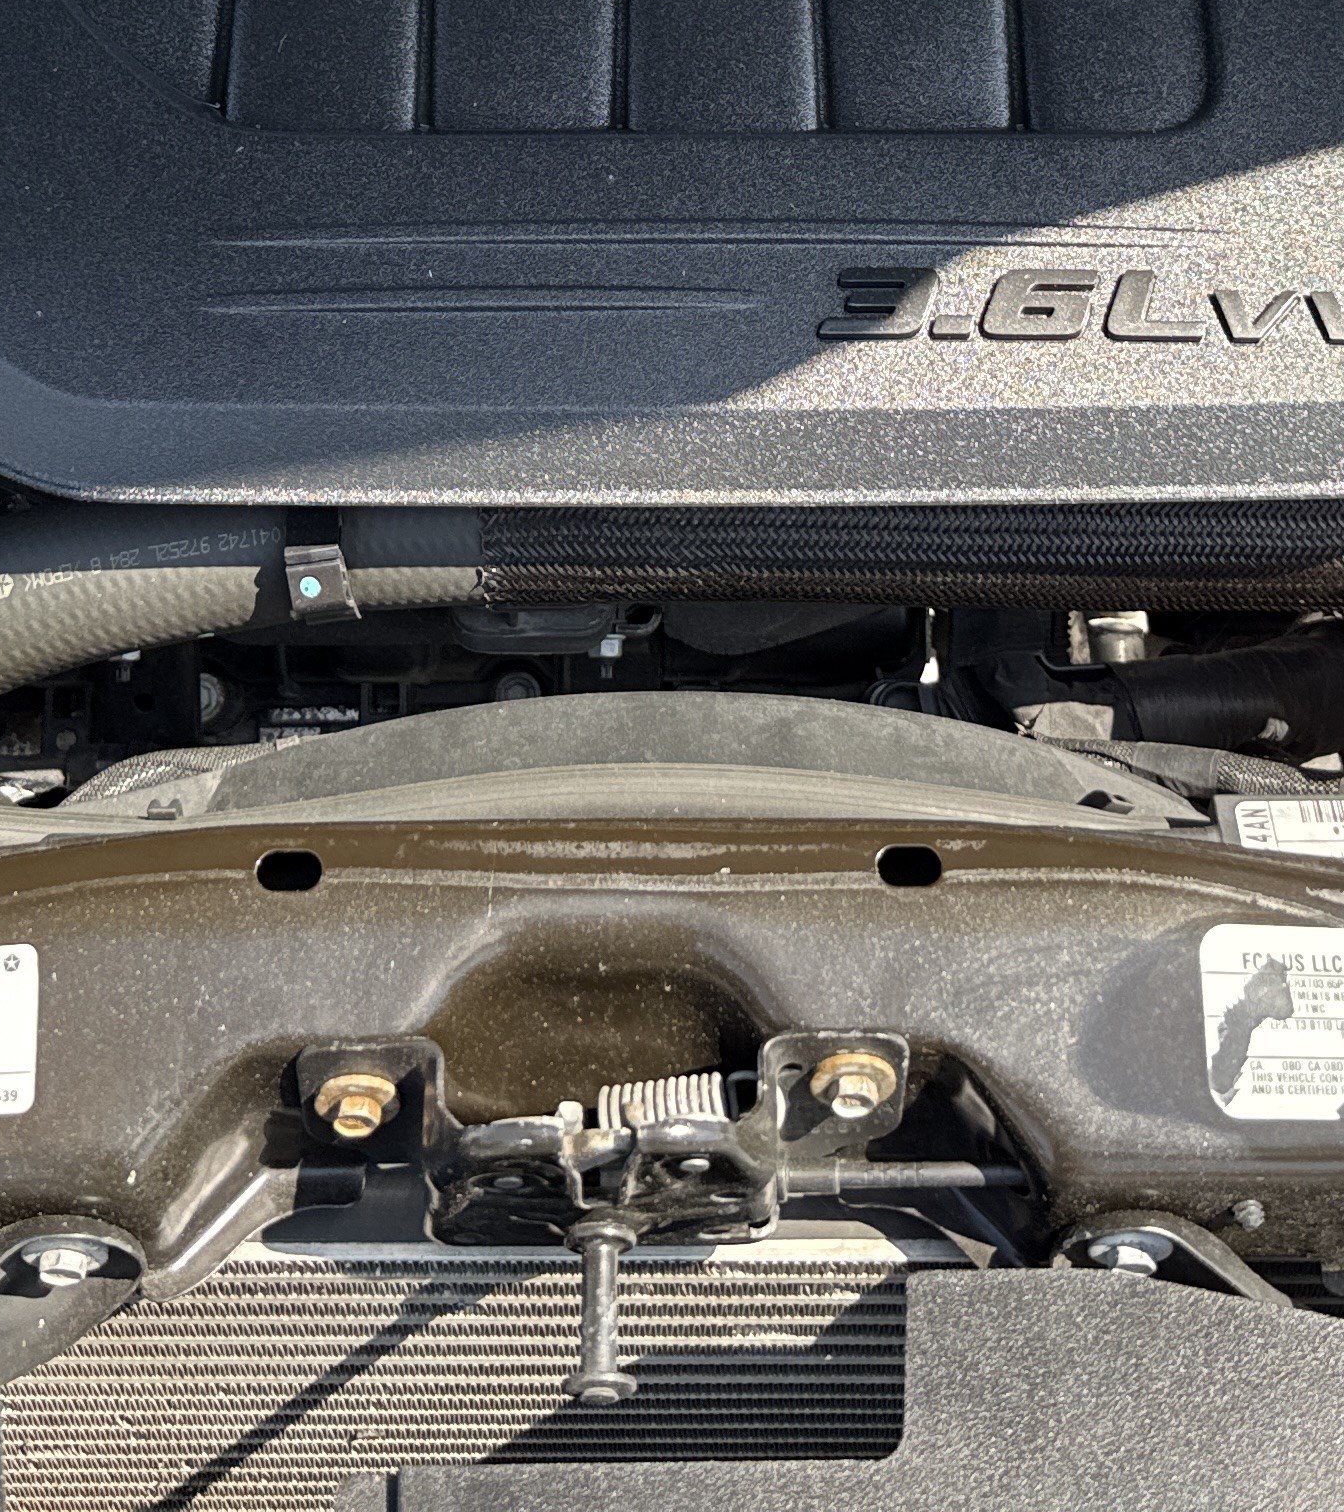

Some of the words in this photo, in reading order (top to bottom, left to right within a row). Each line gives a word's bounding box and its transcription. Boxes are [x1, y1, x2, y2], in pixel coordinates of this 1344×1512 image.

[1312, 955, 1343, 973] LLC
[1251, 1073, 1273, 1082] THIS
[1277, 1073, 1316, 1083] VEHICLE
[1251, 1085, 1271, 1094] AND
[1275, 1085, 1284, 1094] IS
[1288, 1085, 1337, 1095] CERTIFIED
